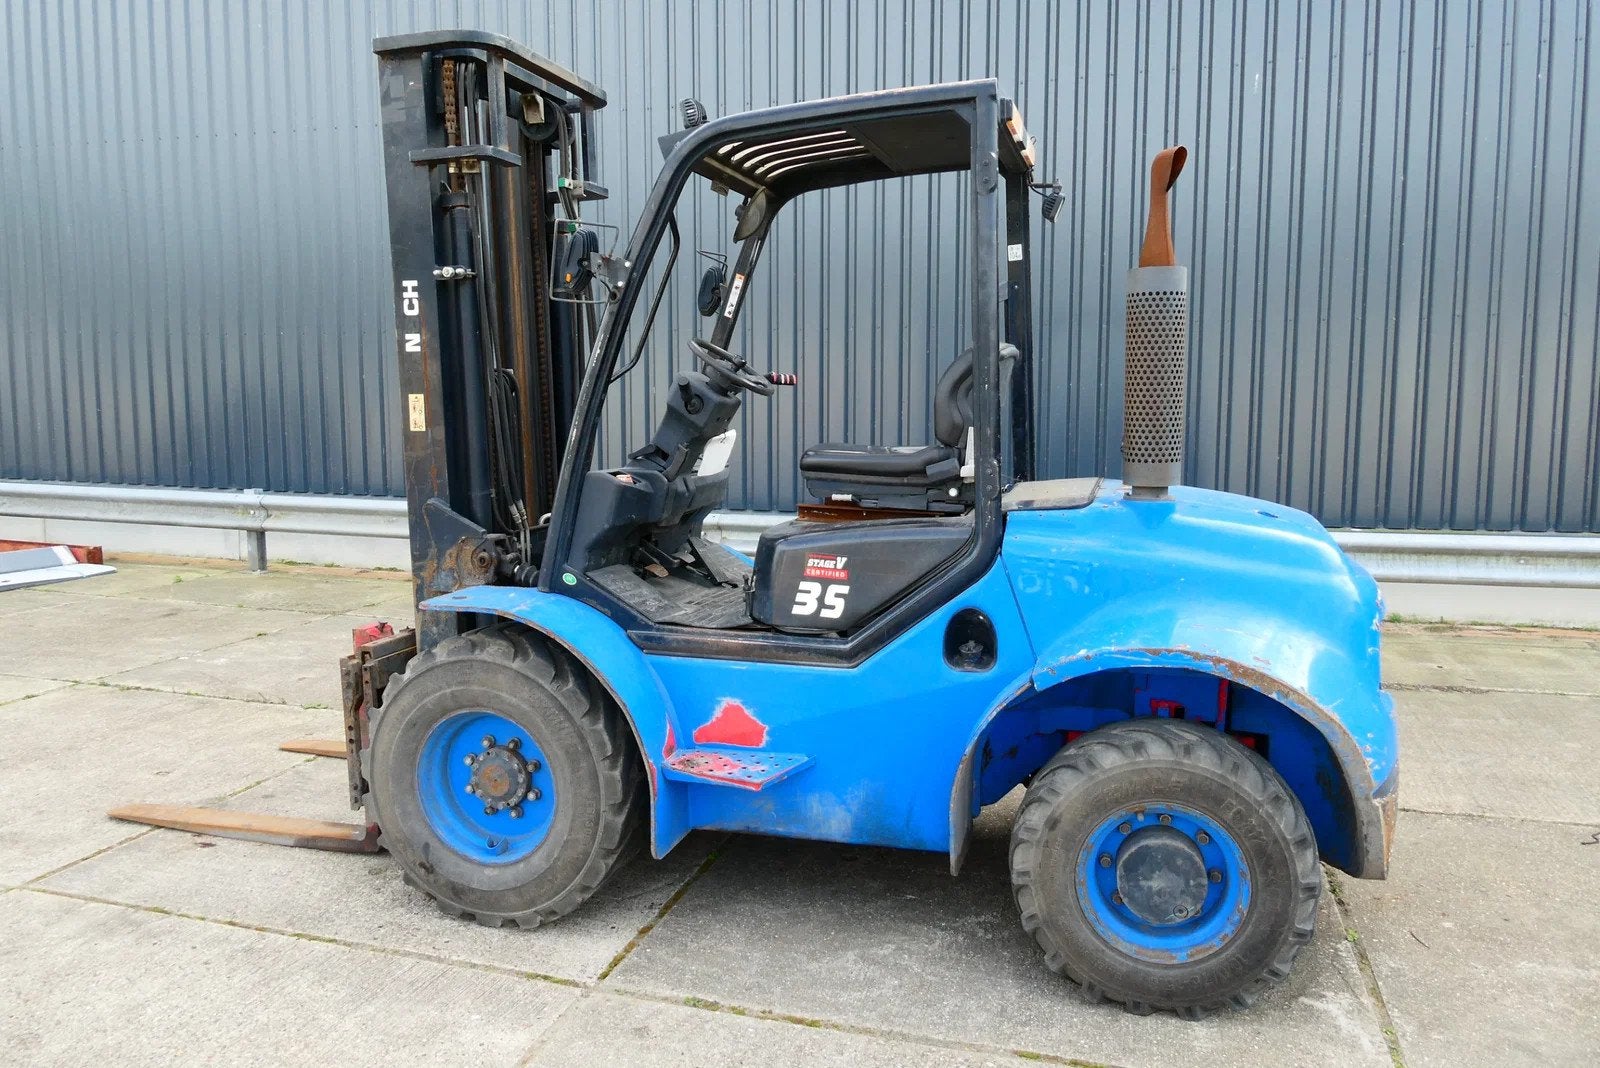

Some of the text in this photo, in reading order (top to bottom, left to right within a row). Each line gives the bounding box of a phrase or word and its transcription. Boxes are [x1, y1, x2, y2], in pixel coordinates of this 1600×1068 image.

[806, 558, 836, 569] STAGE
[806, 568, 846, 578] CERTIFIED
[791, 581, 850, 619] 35
